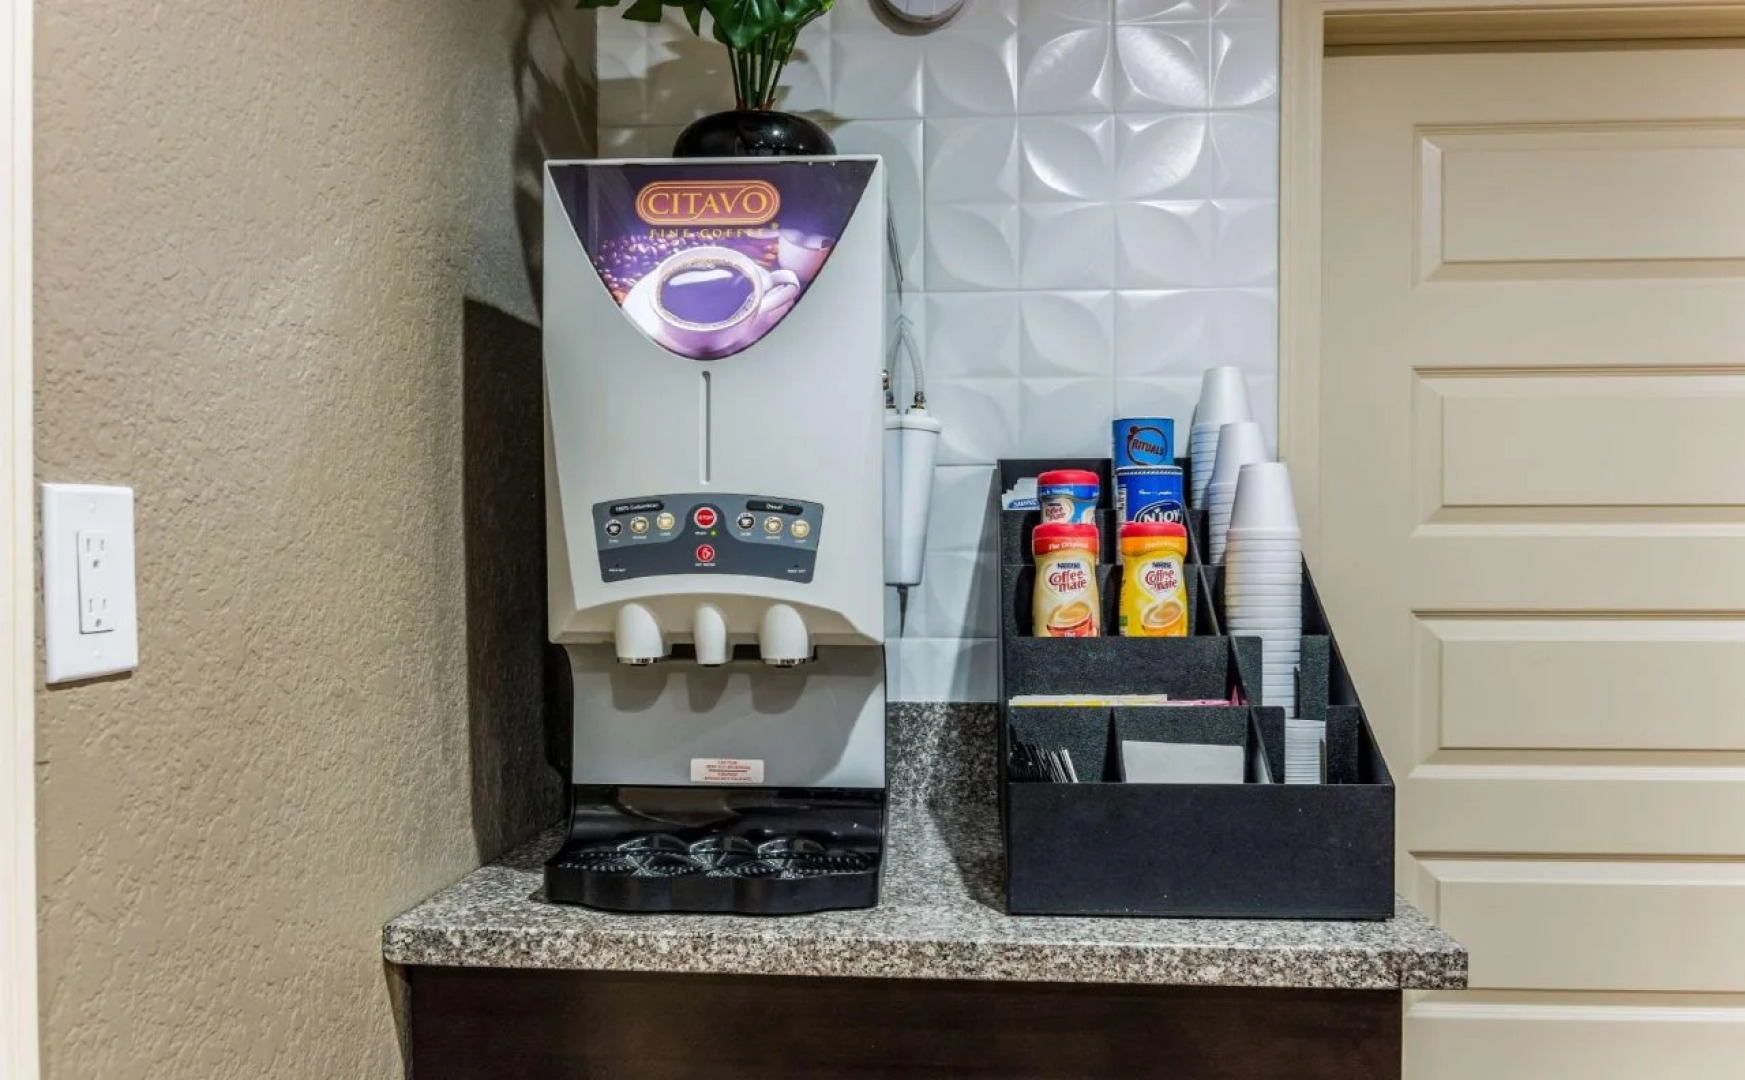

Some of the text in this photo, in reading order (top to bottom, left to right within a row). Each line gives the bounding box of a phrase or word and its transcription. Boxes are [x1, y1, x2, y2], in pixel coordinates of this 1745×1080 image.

[648, 191, 767, 215] CITAVO
[650, 228, 765, 238] FINE COFFEE
